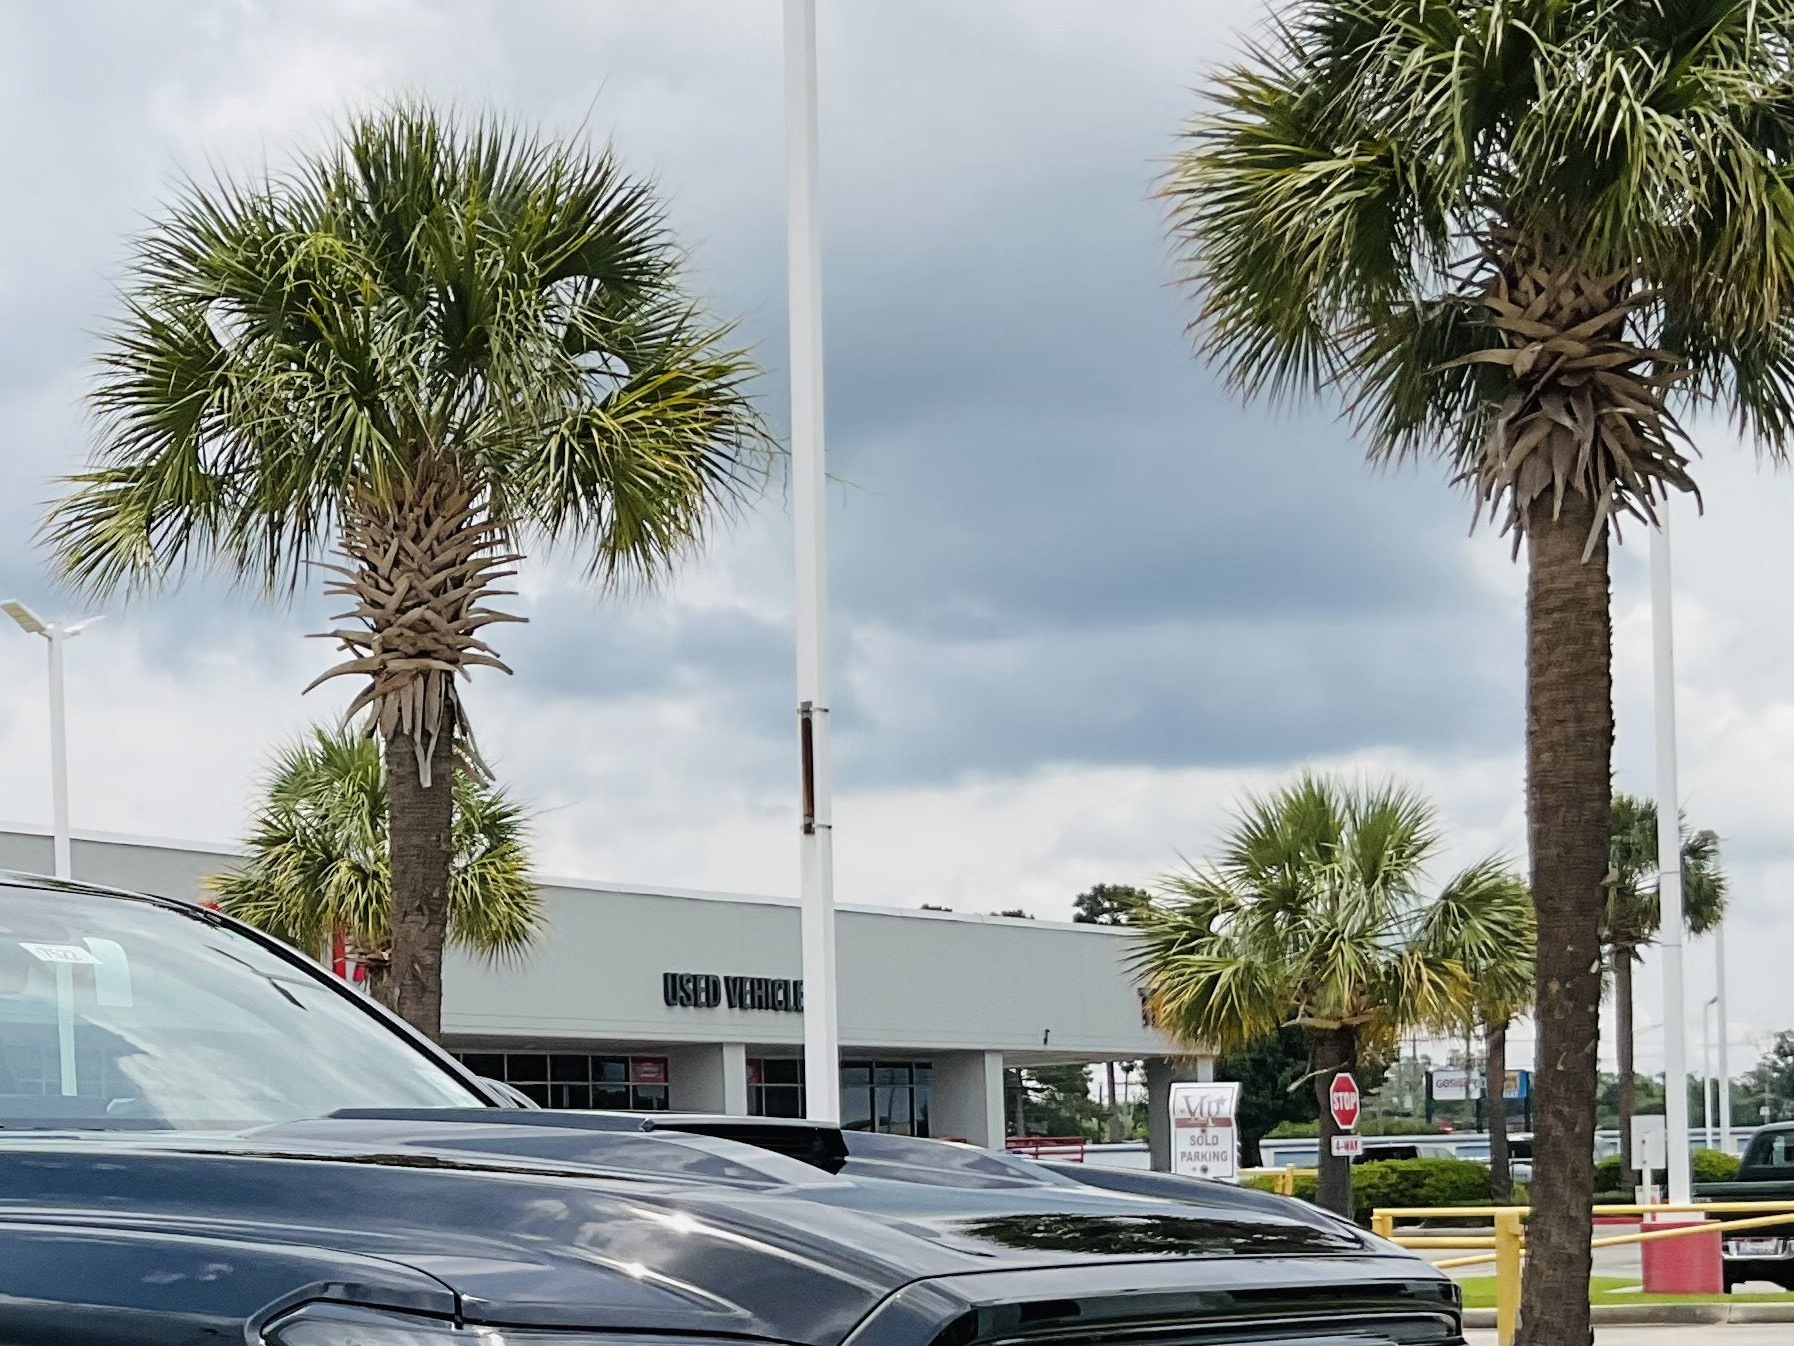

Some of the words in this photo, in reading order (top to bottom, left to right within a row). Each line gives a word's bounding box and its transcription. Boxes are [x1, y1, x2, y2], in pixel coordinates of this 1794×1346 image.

[663, 972, 721, 1008] USED
[1333, 1091, 1356, 1111] STOP
[1189, 1135, 1219, 1146] SOLD
[1335, 1140, 1359, 1152] 4-WAY
[1180, 1151, 1228, 1162] PARKING
